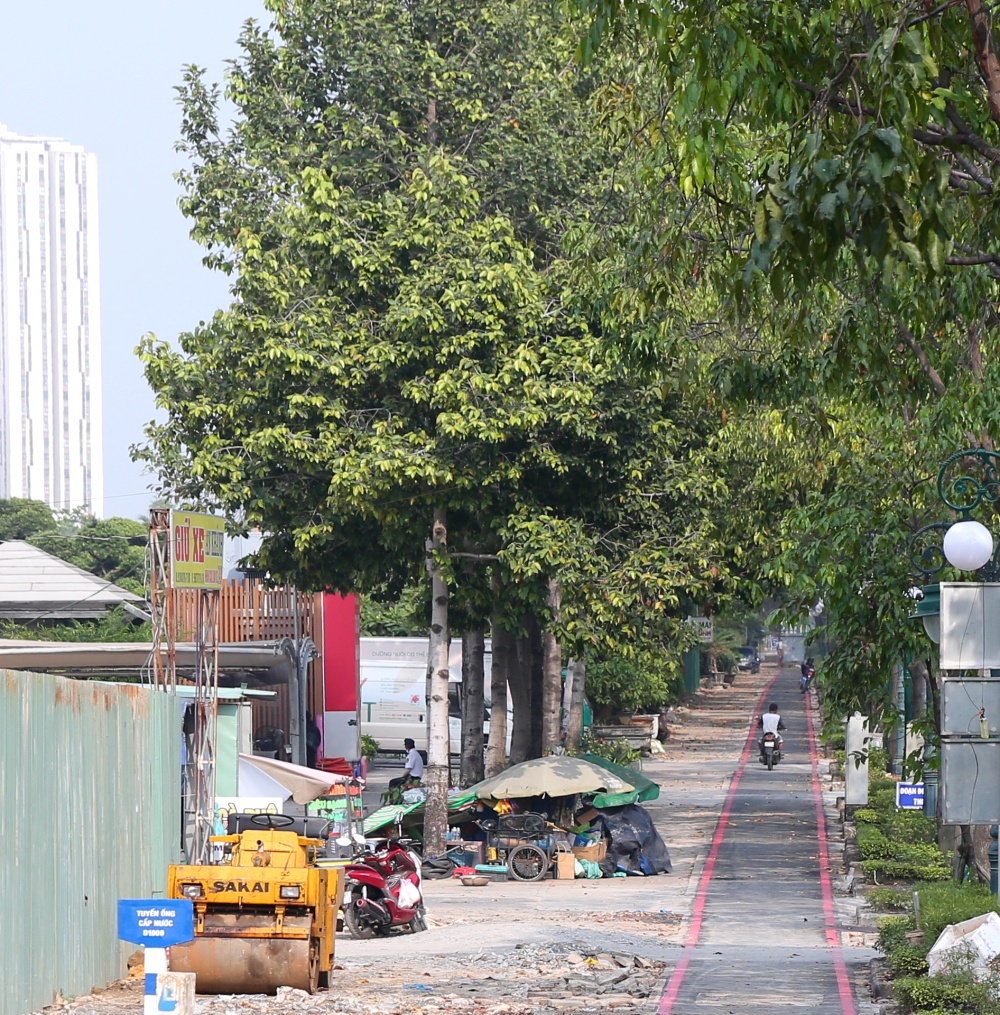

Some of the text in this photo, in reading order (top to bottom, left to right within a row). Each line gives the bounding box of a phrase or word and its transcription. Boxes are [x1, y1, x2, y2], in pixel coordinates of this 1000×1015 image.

[192, 527, 205, 563] XE
[212, 881, 269, 893] SAKAI
[160, 907, 176, 918] ỐNG
[138, 917, 174, 927] CẤP NƯỚC
[142, 929, 165, 937] D1000
